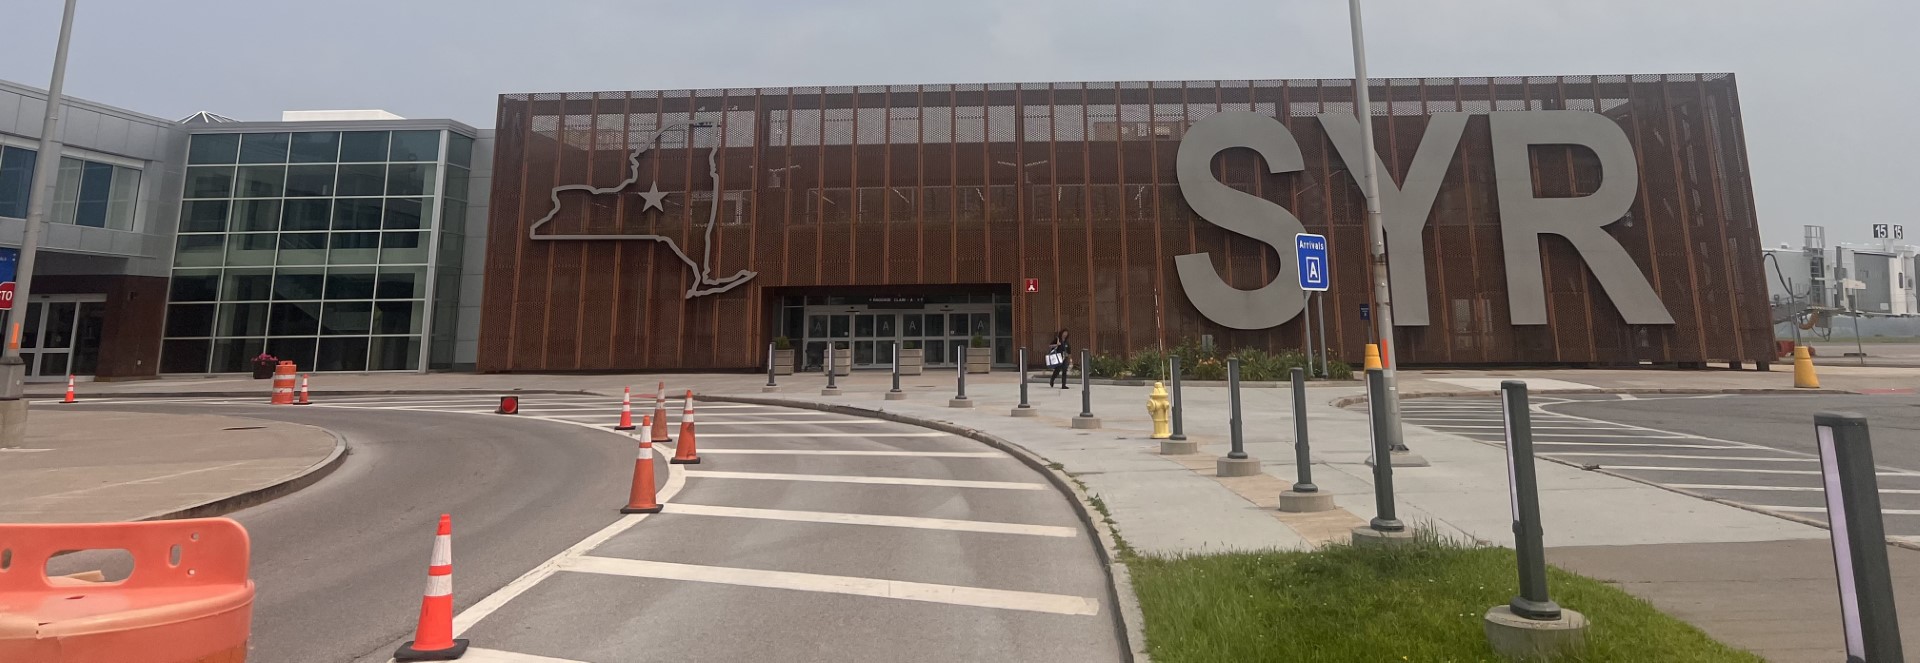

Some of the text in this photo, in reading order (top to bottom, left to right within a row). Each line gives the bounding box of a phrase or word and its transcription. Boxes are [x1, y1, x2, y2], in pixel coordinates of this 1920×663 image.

[1174, 110, 1676, 329] SYR
[1875, 224, 1887, 238] 15
[1299, 240, 1324, 250] Arrivals
[1309, 261, 1318, 278] A
[882, 321, 890, 331] A
[908, 320, 916, 330] A
